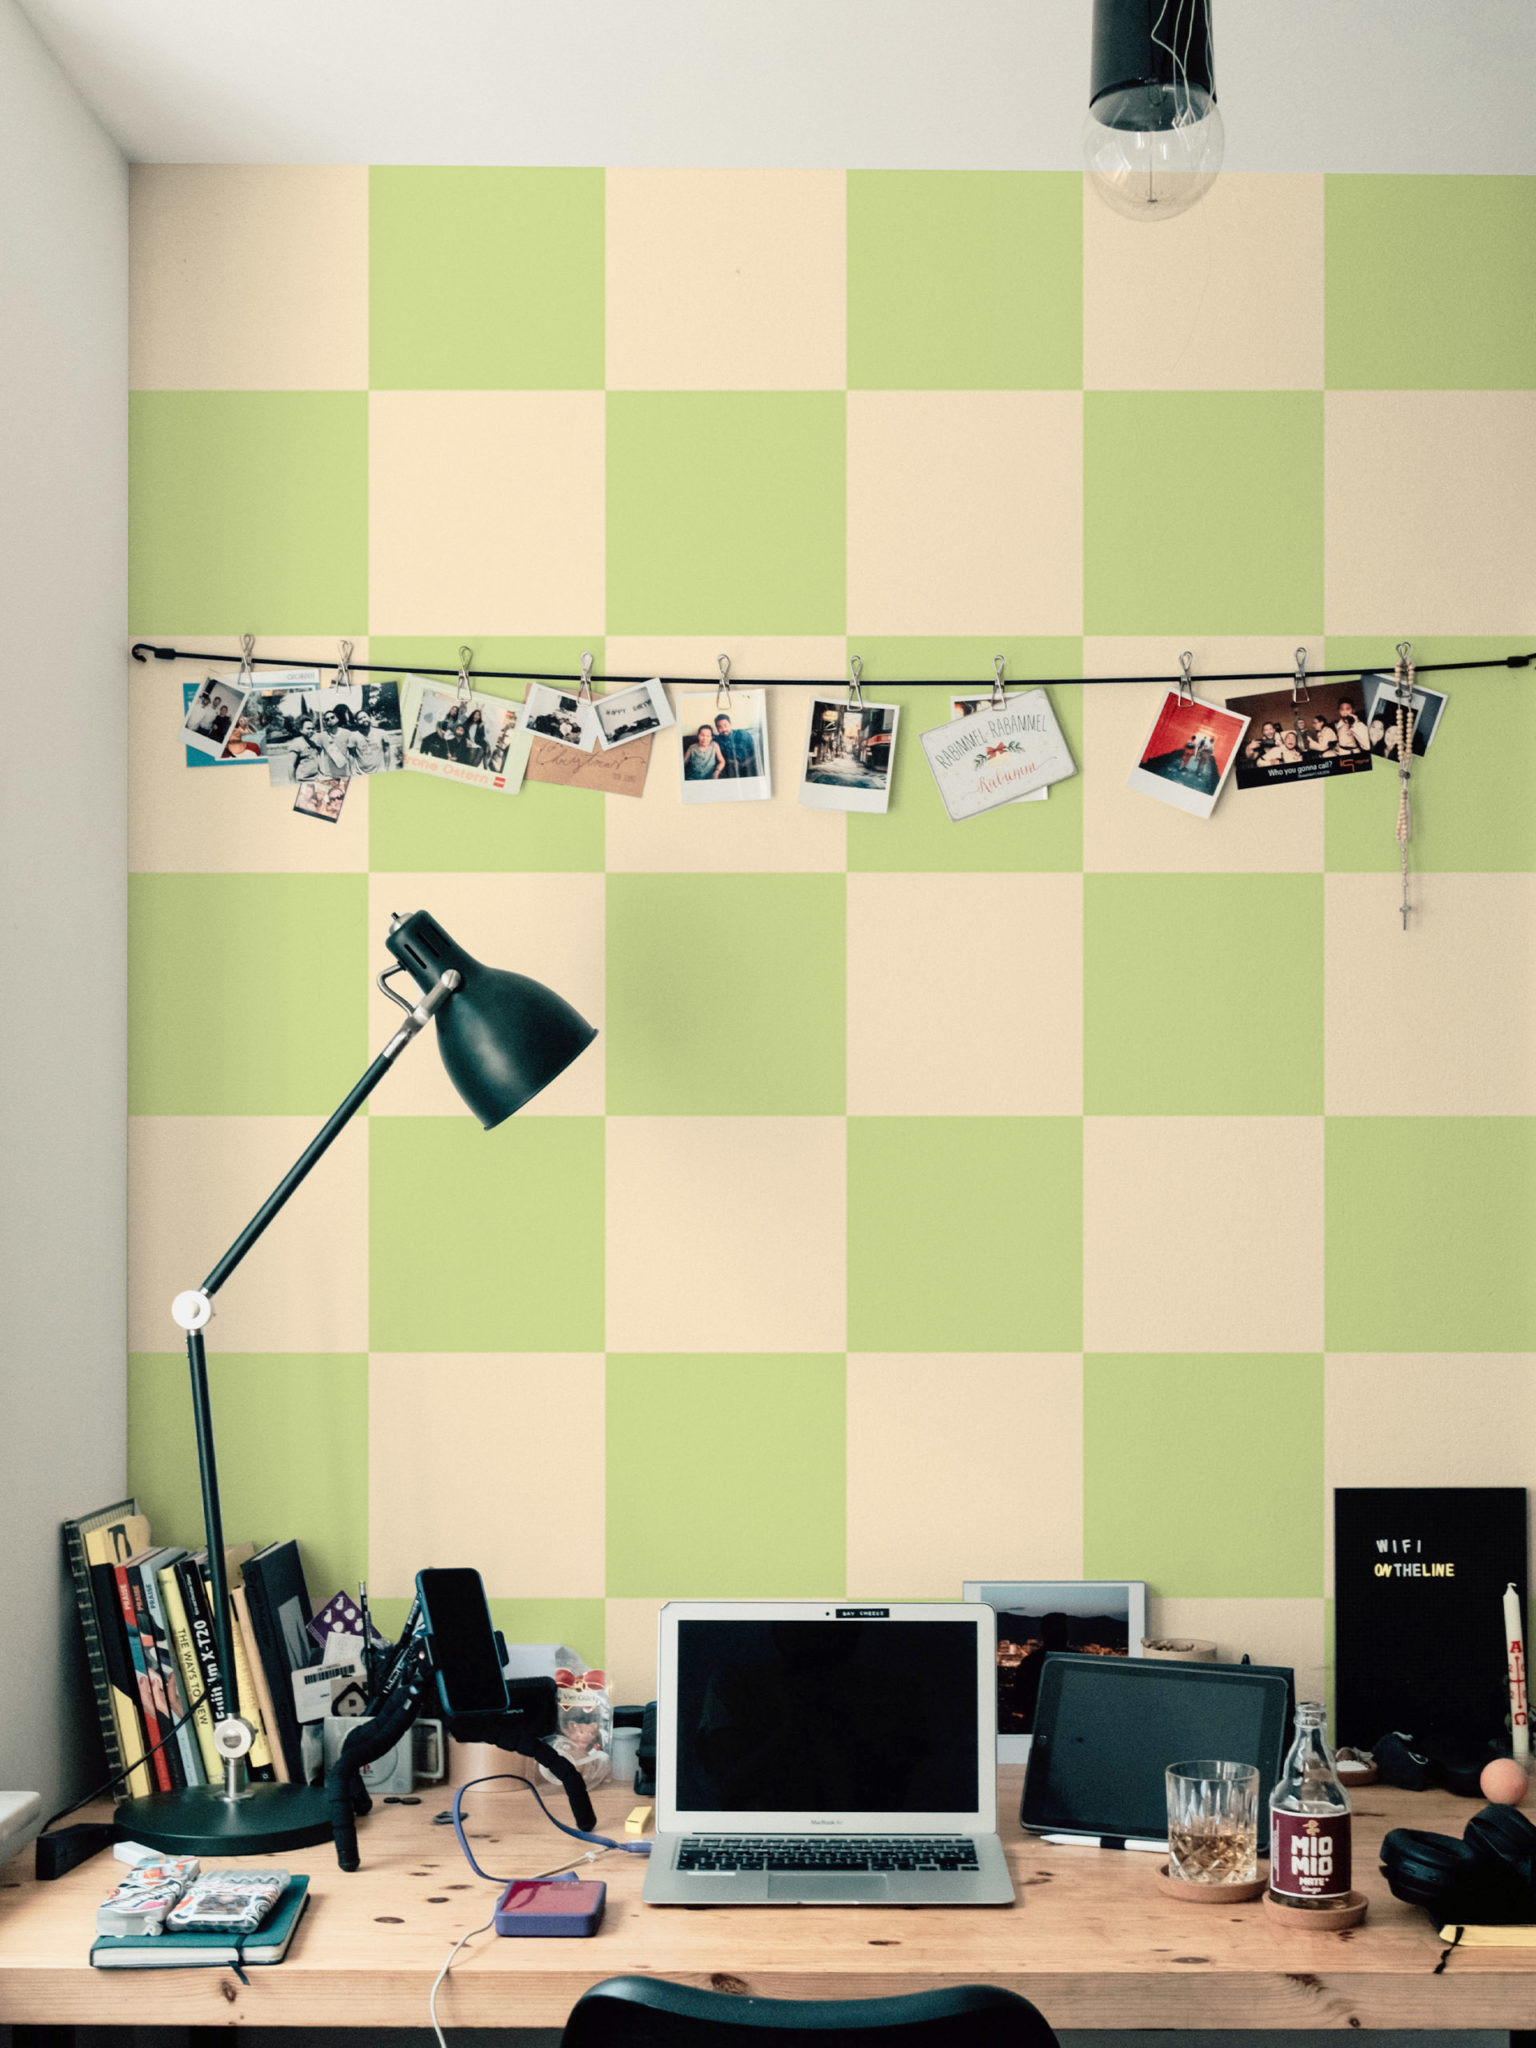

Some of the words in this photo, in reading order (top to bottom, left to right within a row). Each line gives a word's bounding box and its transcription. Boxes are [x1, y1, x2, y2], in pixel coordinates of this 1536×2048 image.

[934, 728, 988, 770] RABIMMEL
[988, 714, 1047, 739] RABAMMEL
[1268, 767, 1284, 777] Who
[1284, 767, 1297, 776] you
[1298, 764, 1317, 775] gonna
[1318, 760, 1333, 770] call?
[1376, 1539, 1422, 1554] WIFI
[119, 1583, 132, 1611] PRAISE
[132, 1585, 145, 1612] PRAISE
[145, 1583, 157, 1610] PRAISE
[177, 1627, 190, 1649] THE
[193, 1620, 216, 1662] X-T20
[184, 1652, 198, 1681] WAYS
[190, 1681, 201, 1698] TO
[1291, 1835, 1333, 1856] MIO
[1291, 1856, 1333, 1876] MIO
